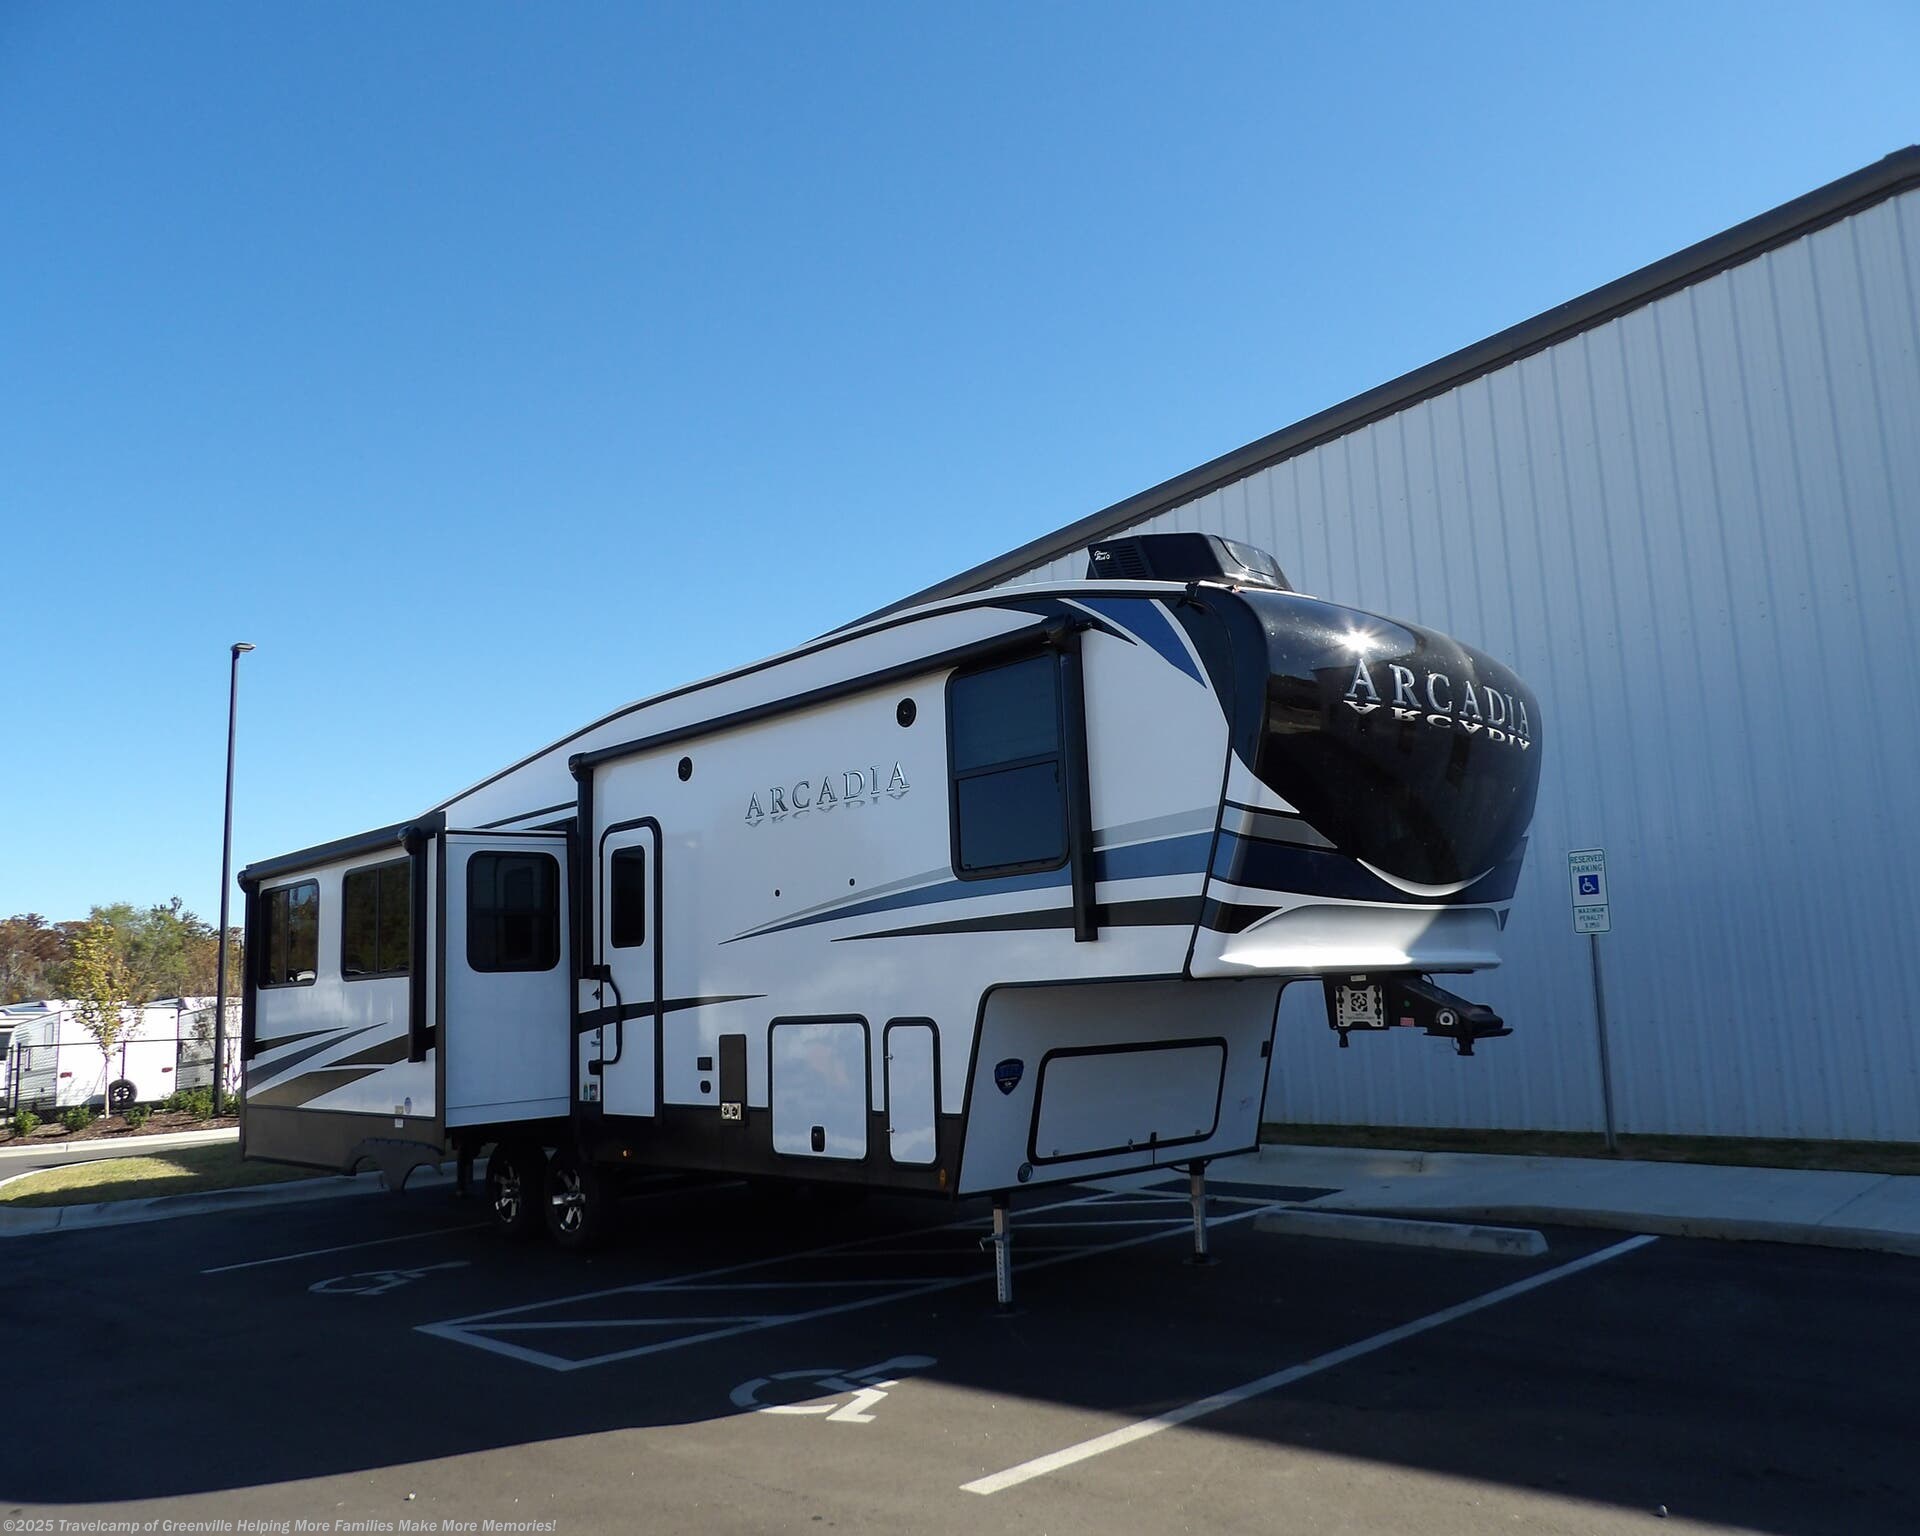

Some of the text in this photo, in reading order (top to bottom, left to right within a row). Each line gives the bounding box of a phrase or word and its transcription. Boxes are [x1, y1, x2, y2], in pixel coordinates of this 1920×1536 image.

[1344, 658, 1531, 740] ARCADIA
[745, 761, 911, 820] ARCADIA
[1569, 854, 1603, 864] RESERVED
[1572, 863, 1603, 873] PARKING
